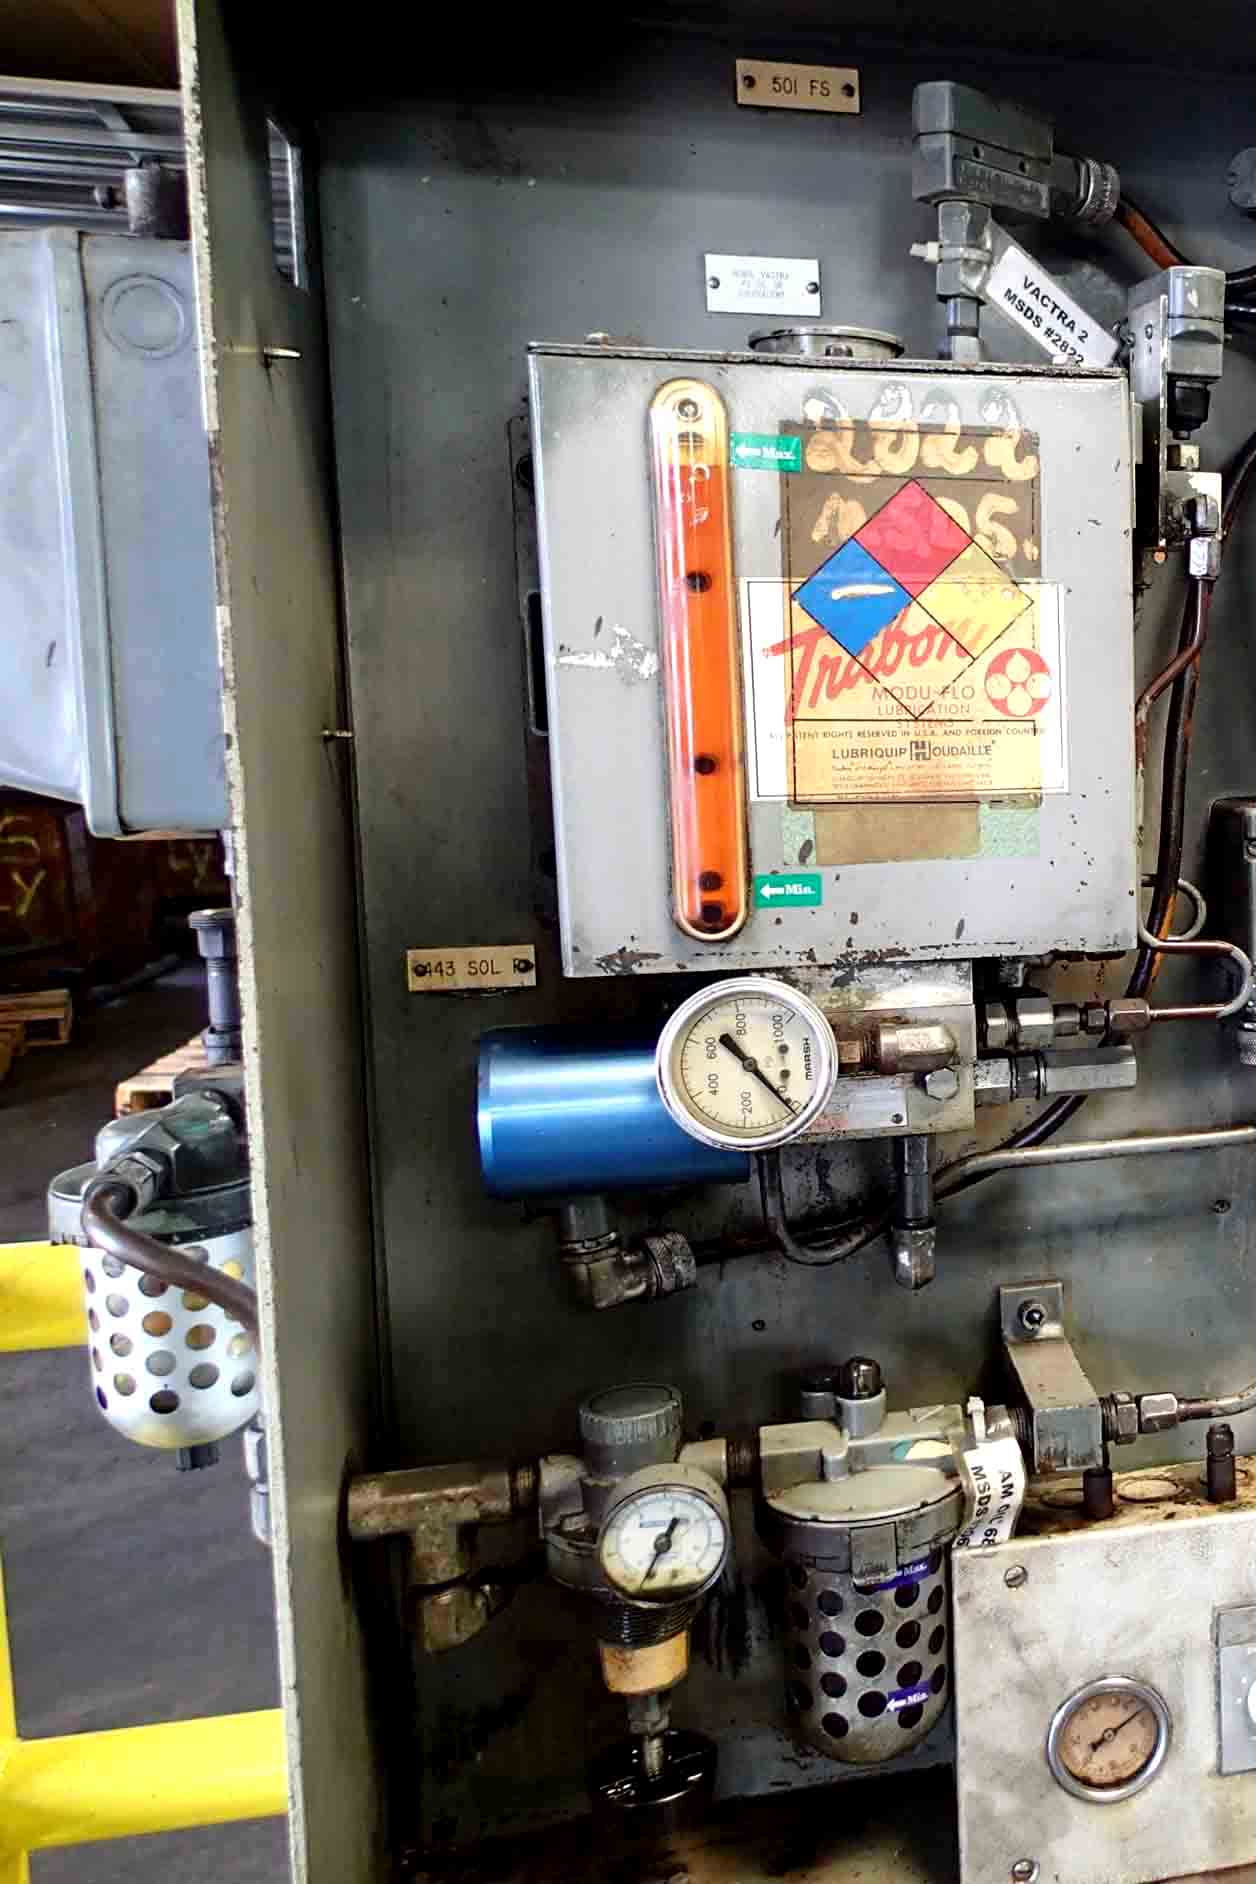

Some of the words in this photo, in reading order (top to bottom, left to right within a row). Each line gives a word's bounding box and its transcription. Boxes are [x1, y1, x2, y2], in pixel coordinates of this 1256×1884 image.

[809, 79, 831, 97] FS
[1004, 287, 1043, 328] MSDS
[1022, 275, 1076, 334] VACTRA
[1077, 330, 1089, 344] 2
[877, 703, 971, 717] LUBRICATION
[823, 729, 853, 739] RIGHTS
[857, 729, 897, 738] RESERVED
[943, 728, 961, 736] AND
[965, 727, 1002, 736] FOREIGN
[831, 747, 907, 760] LUBRIQUIP
[467, 960, 504, 976] SOL
[736, 1013, 746, 1036] 800
[774, 1014, 784, 1044] 1000
[705, 1036, 716, 1060] 600
[803, 1037, 814, 1081] MARSH
[708, 1073, 720, 1096] 400
[741, 1091, 753, 1114] 200
[971, 1465, 993, 1518] MSDS
